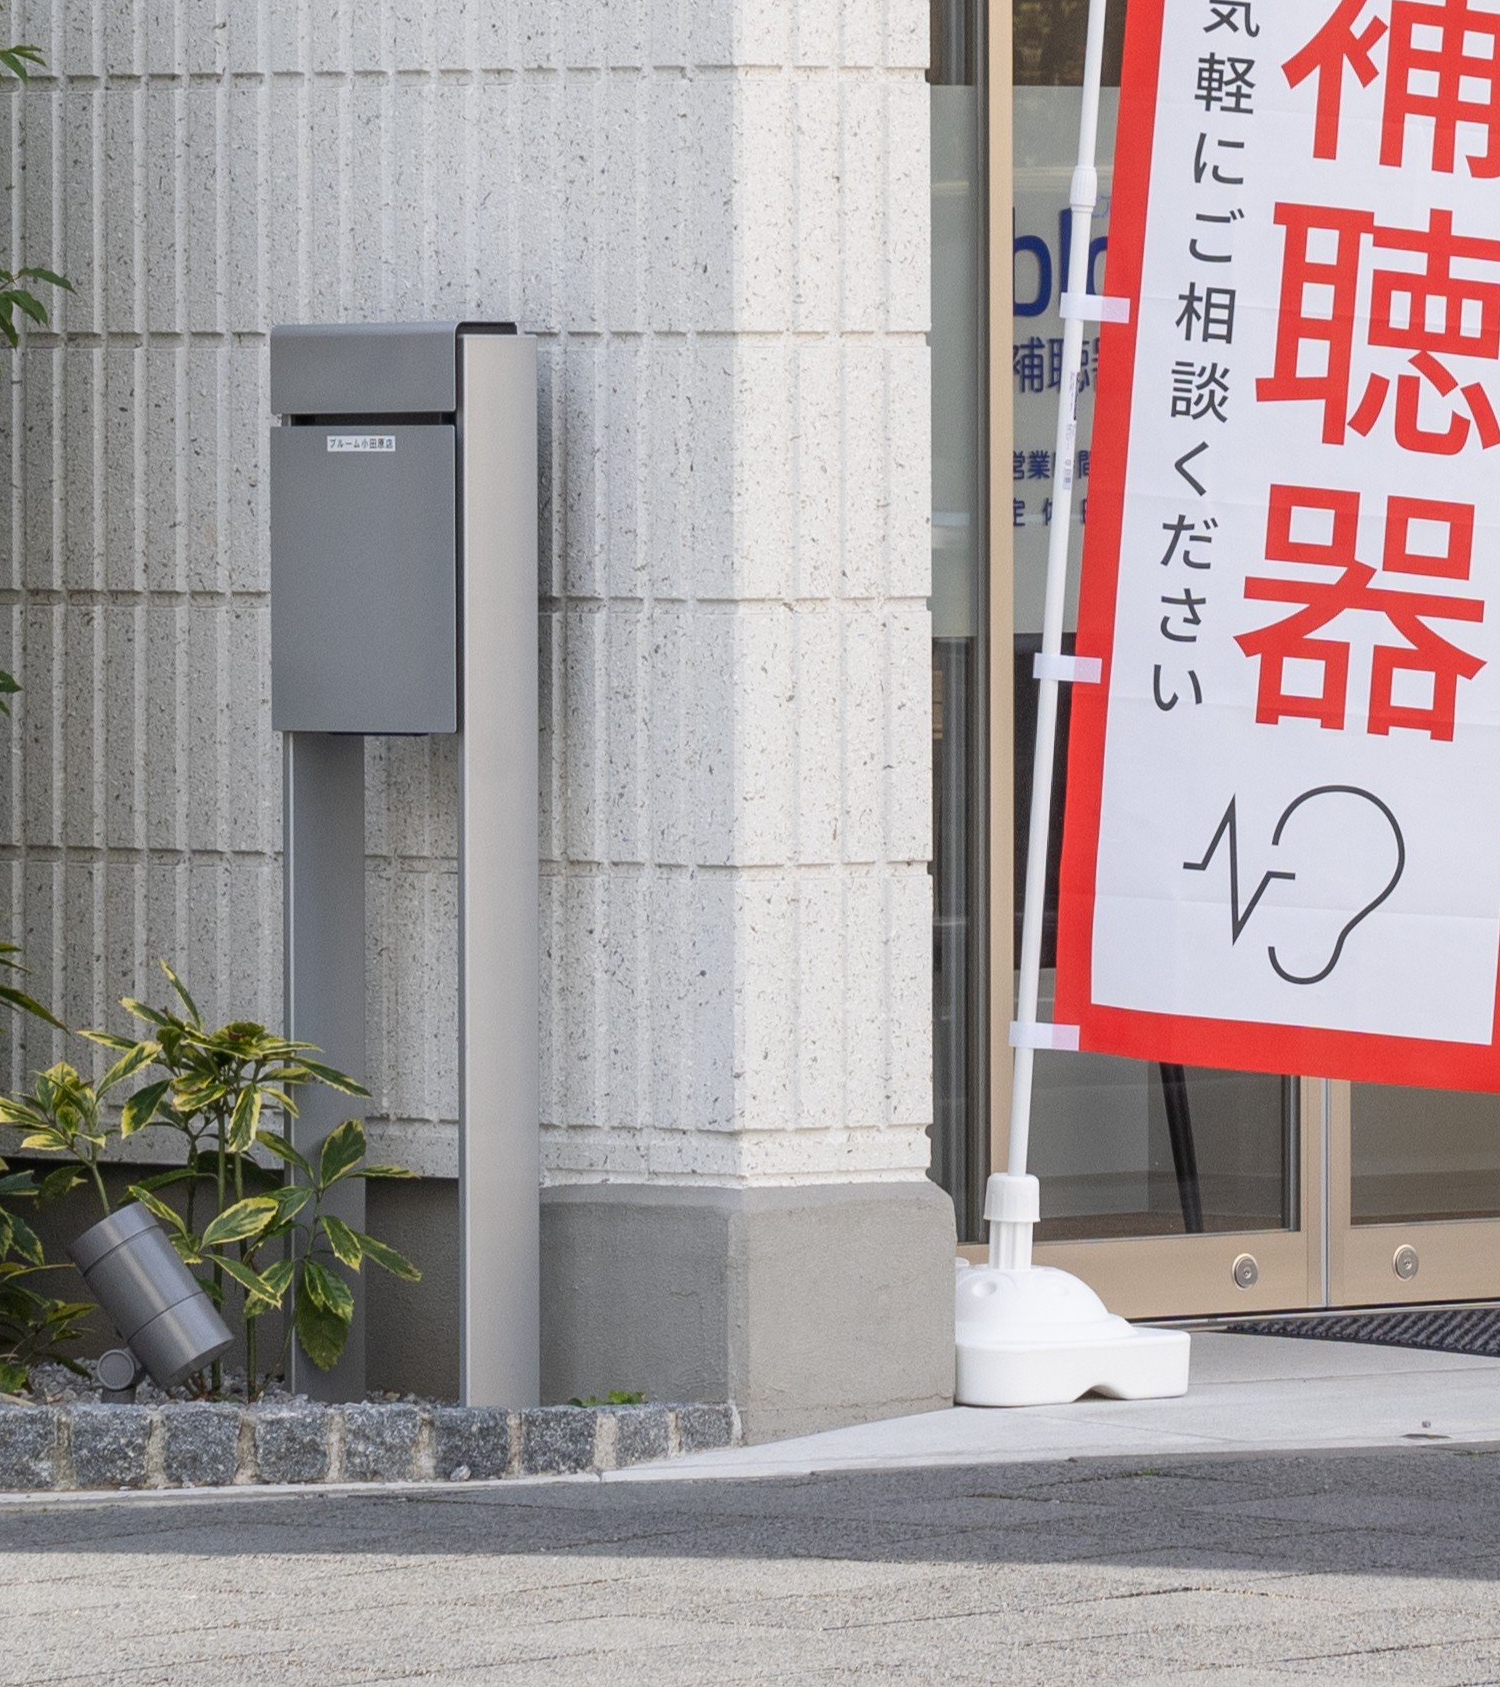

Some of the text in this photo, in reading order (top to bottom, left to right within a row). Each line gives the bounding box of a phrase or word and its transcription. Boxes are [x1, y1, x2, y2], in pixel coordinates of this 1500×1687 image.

[1012, 336, 1100, 395] 補聴
[329, 438, 393, 449] ブルーム小田原店
